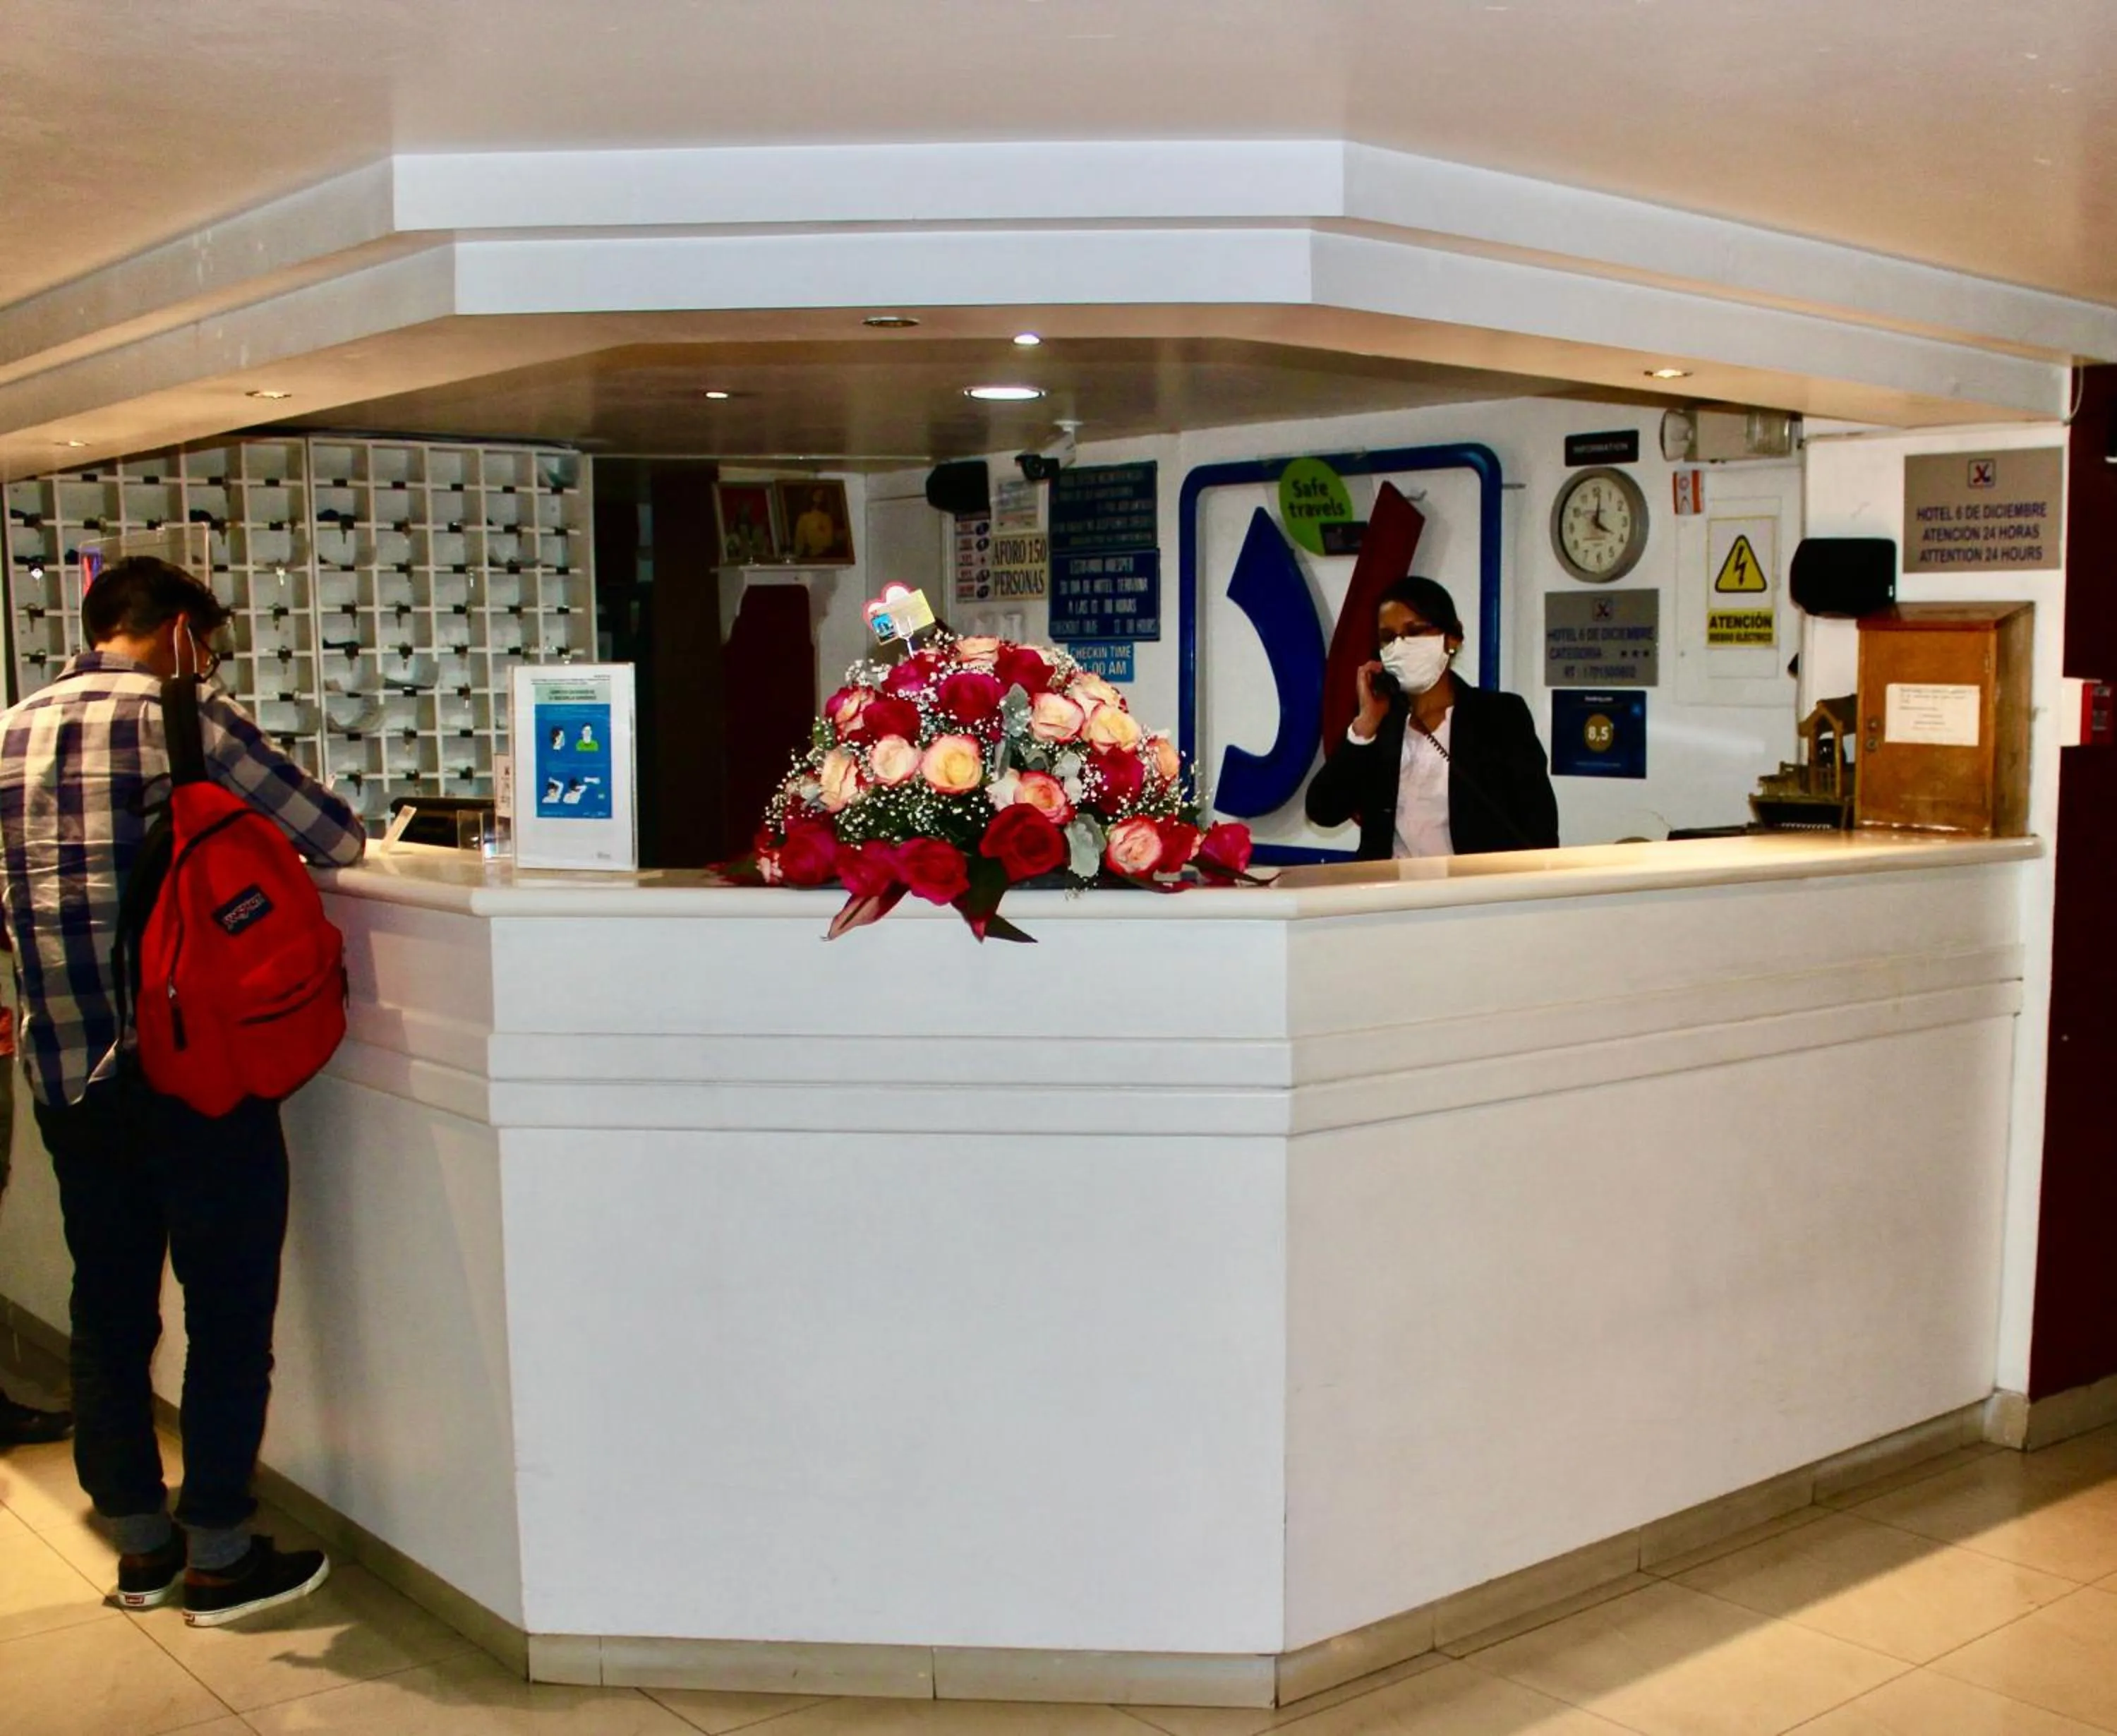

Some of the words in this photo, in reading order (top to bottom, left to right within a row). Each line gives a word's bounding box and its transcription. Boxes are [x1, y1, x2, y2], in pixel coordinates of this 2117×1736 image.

[1292, 477, 1328, 498] Safe
[1289, 497, 1345, 517] travels
[1917, 506, 1953, 521] HOTEL
[1956, 505, 1962, 519] 6
[1965, 505, 1981, 519] DE
[1983, 502, 2046, 519] DICIEMBRE
[1983, 526, 1996, 541] 24
[1998, 524, 2040, 539] HORAS
[994, 540, 1027, 565] AFORO
[1029, 538, 1047, 564] 150
[1920, 548, 1982, 562] ATTENTION
[1986, 548, 1998, 561] 24
[2001, 546, 2042, 560] HOURS
[995, 570, 1045, 596] PERSONAS
[1710, 613, 1773, 628] ATENCIÓN
[1070, 647, 1107, 661] CHECKIN
[1110, 646, 1130, 658] TIME
[1109, 661, 1126, 675] AM
[1588, 725, 1609, 742] 8,5
